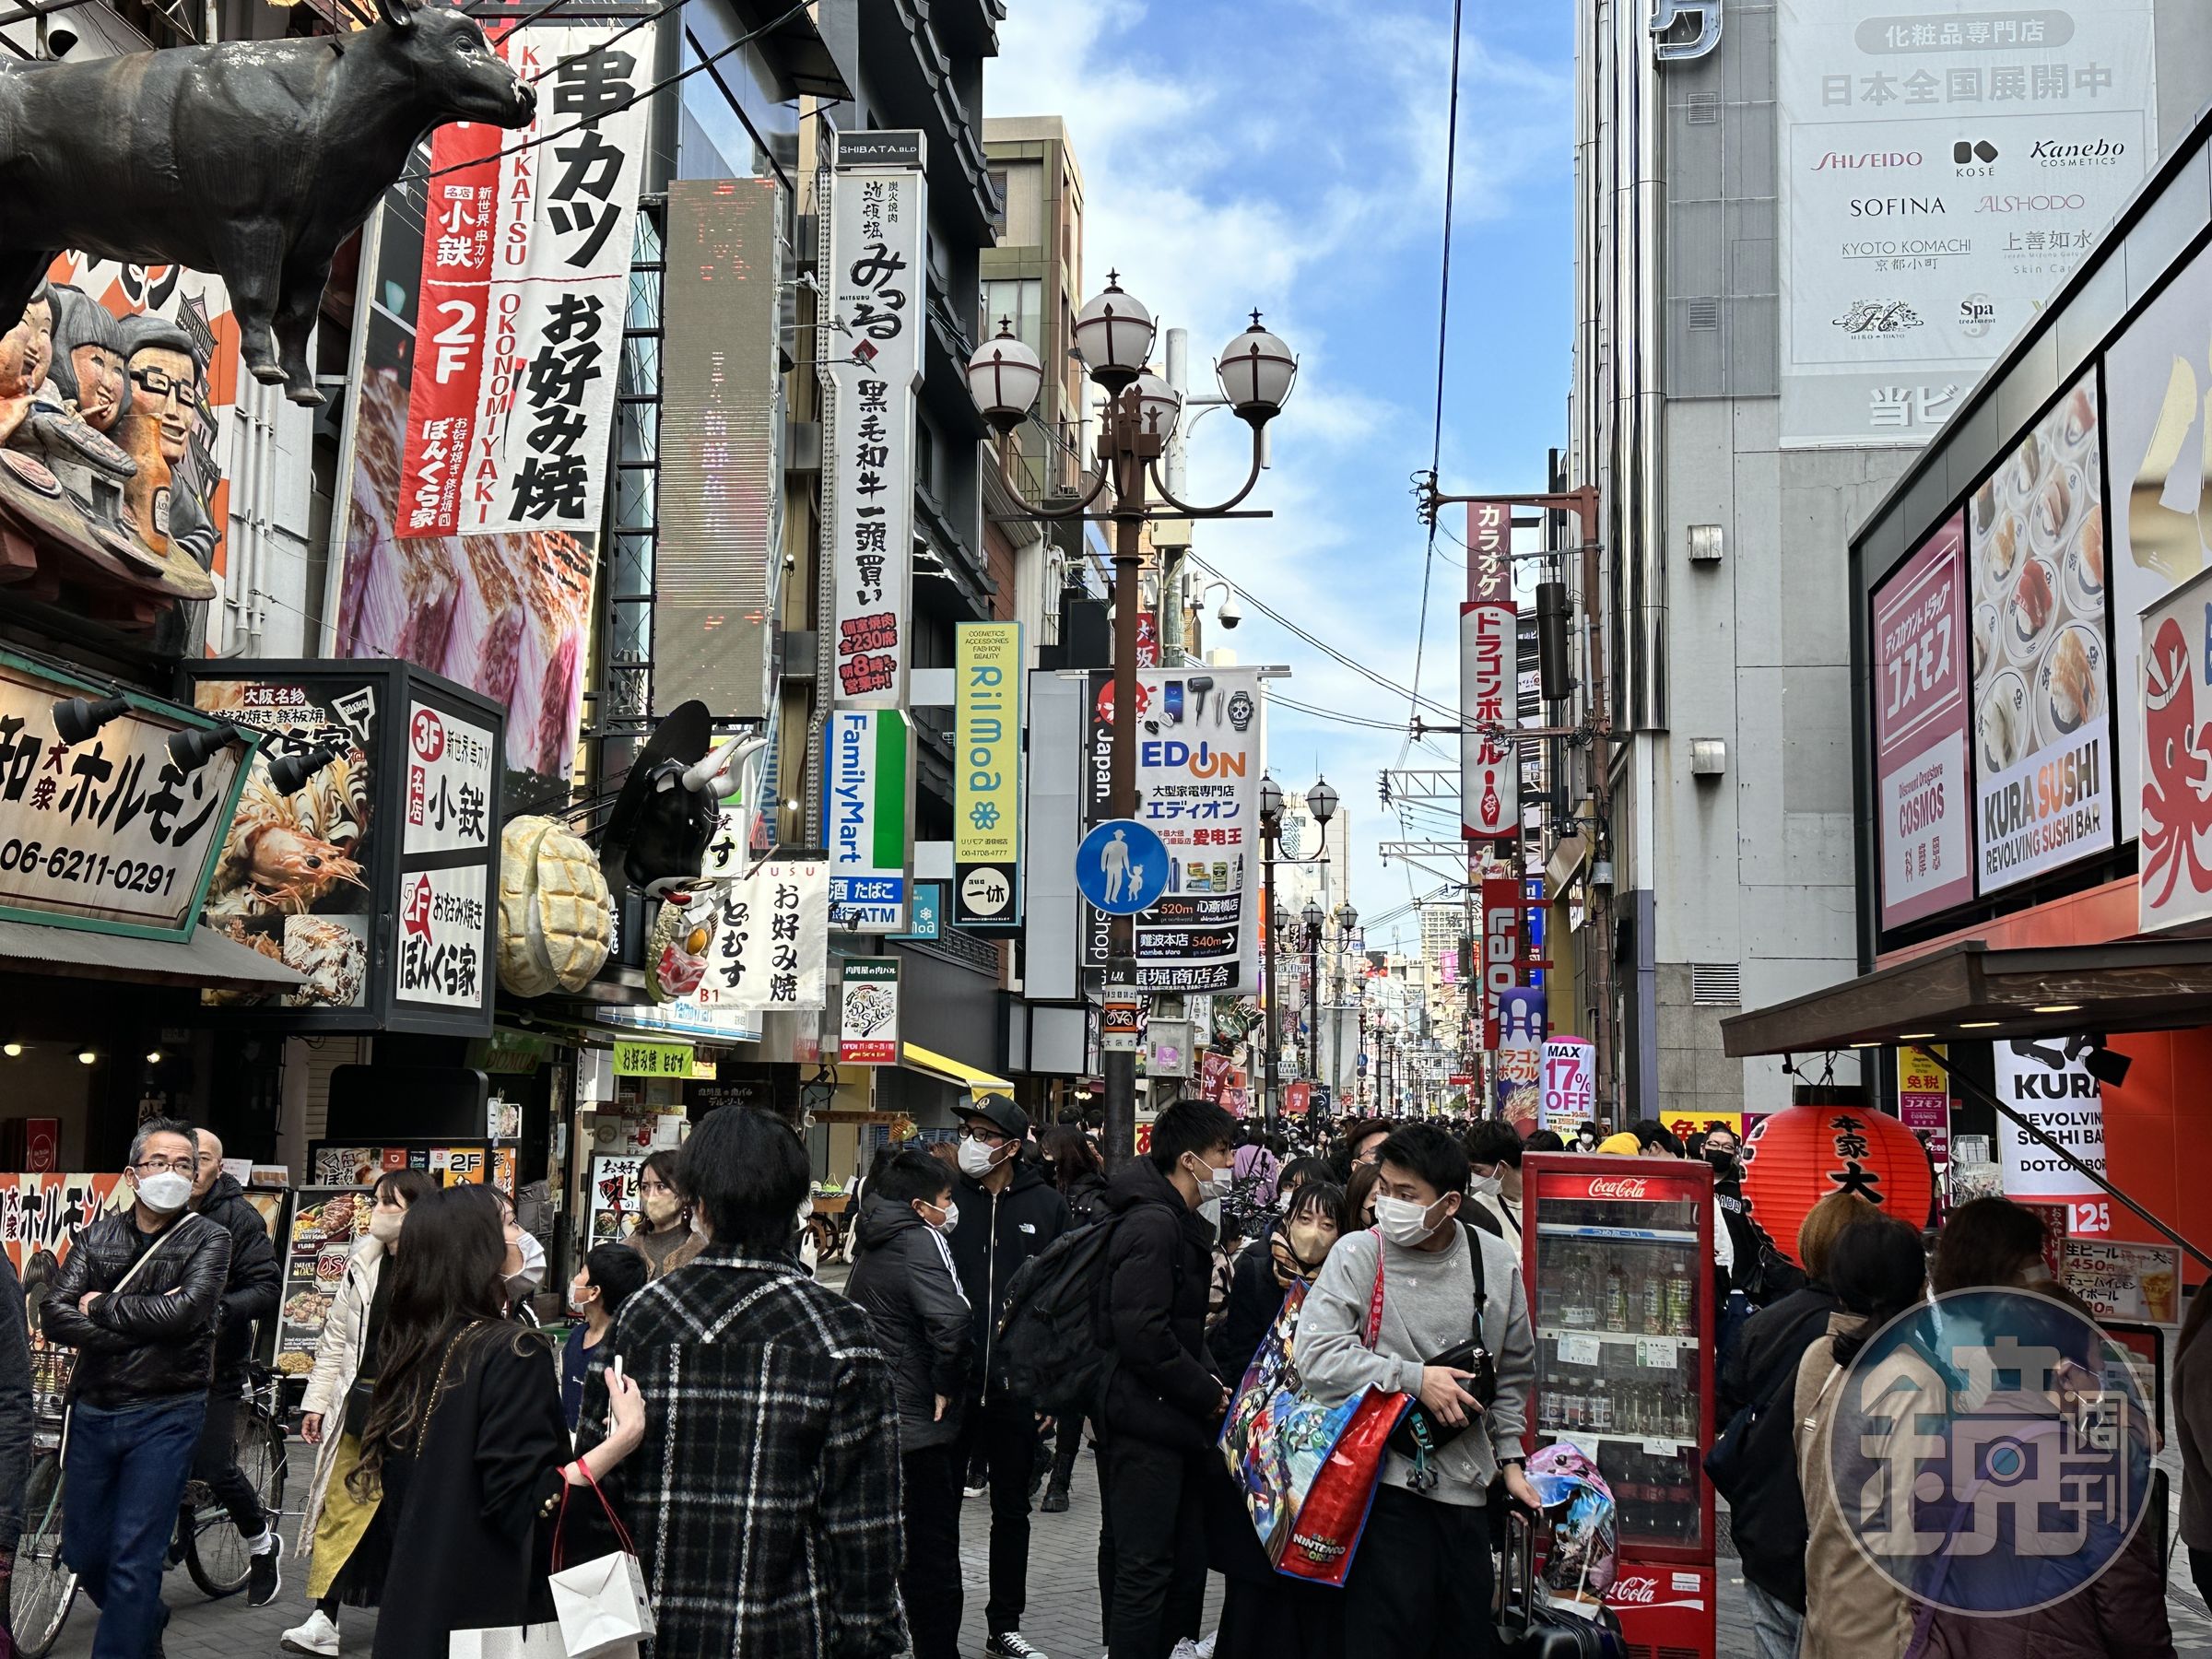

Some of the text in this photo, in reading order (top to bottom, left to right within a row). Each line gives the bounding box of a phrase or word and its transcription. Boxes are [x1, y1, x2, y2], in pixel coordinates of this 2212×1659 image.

[1885, 21, 2045, 48] 化粧品専門店
[1821, 61, 2112, 107] 日本全国展開中
[505, 45, 541, 265] KUIKATSU
[548, 44, 637, 268] 串カツ
[1811, 151, 1923, 171] SHISEIDO
[2030, 138, 2124, 159] Kanebo
[2041, 157, 2116, 168] COSMETICS
[444, 186, 473, 199] 名店
[888, 182, 899, 223] 炭火焼肉
[1850, 197, 1946, 217] SOFINA
[862, 181, 887, 240] 道頓堀
[474, 187, 492, 270] 新世界 串カツ
[2002, 229, 2093, 252] 上善如水
[1842, 239, 1971, 256] KYOTO KOMACHI
[1875, 257, 1939, 272] 京都小町
[2014, 265, 2042, 274] Skin
[850, 242, 908, 340] みつる
[1960, 300, 1994, 322] Spa
[433, 300, 477, 384] 2F
[473, 293, 521, 524] OKONOMIYAKI
[508, 293, 605, 523] お好み焼
[409, 418, 454, 528] ぼんくら家
[855, 380, 889, 606] 黒毛和牛一頭買い
[1477, 504, 1502, 598] カラオケ
[1887, 613, 1951, 720] コスモス
[244, 688, 306, 705] 大阪名物
[276, 709, 324, 724] 鉄板焼
[970, 665, 1003, 792] Rilmoa
[416, 715, 441, 754] 3F
[1092, 728, 1114, 804] Japan.
[1141, 740, 1246, 780] EDION
[58, 741, 219, 848] ホルモン
[411, 769, 425, 822] 名店
[834, 714, 867, 864] FamilyMart
[1152, 785, 1234, 797] 大型家電専門店
[1984, 738, 2100, 843] KURA SUSHI
[429, 774, 485, 842] 小鉄
[1146, 800, 1241, 819] エディオン
[1900, 782, 1945, 839] COSMOS
[1985, 823, 2041, 876] REVOLVING
[2041, 812, 2075, 854] SUSHI
[2076, 805, 2101, 840] BAR
[0, 838, 176, 897] 06-6211-0291
[403, 882, 430, 923] 2F
[830, 878, 895, 900] 酒 たばこ
[967, 885, 1005, 903] 一休
[433, 891, 483, 931] お好み焼き
[1160, 903, 1194, 914] 520m
[770, 883, 799, 1002] お好み焼
[1140, 933, 1188, 947] 難波本店
[1192, 935, 1222, 947] 540m
[400, 934, 477, 996] ぼんくら家
[700, 988, 721, 1003] B1
[1547, 1045, 1582, 1058] MAX
[1499, 1065, 1539, 1079] ボウル
[1546, 1058, 1592, 1092] 17%
[1907, 1075, 1940, 1089] 免税
[1546, 1090, 1590, 1112] OFF
[1905, 1100, 1942, 1108] コスモス
[2018, 1112, 2104, 1126] REVOLVIN
[450, 1153, 482, 1173] 2F
[1588, 1177, 1648, 1198] Coca-Cola
[2065, 1244, 2119, 1259] 生ビール
[1293, 1533, 1346, 1555] NINTENDO
